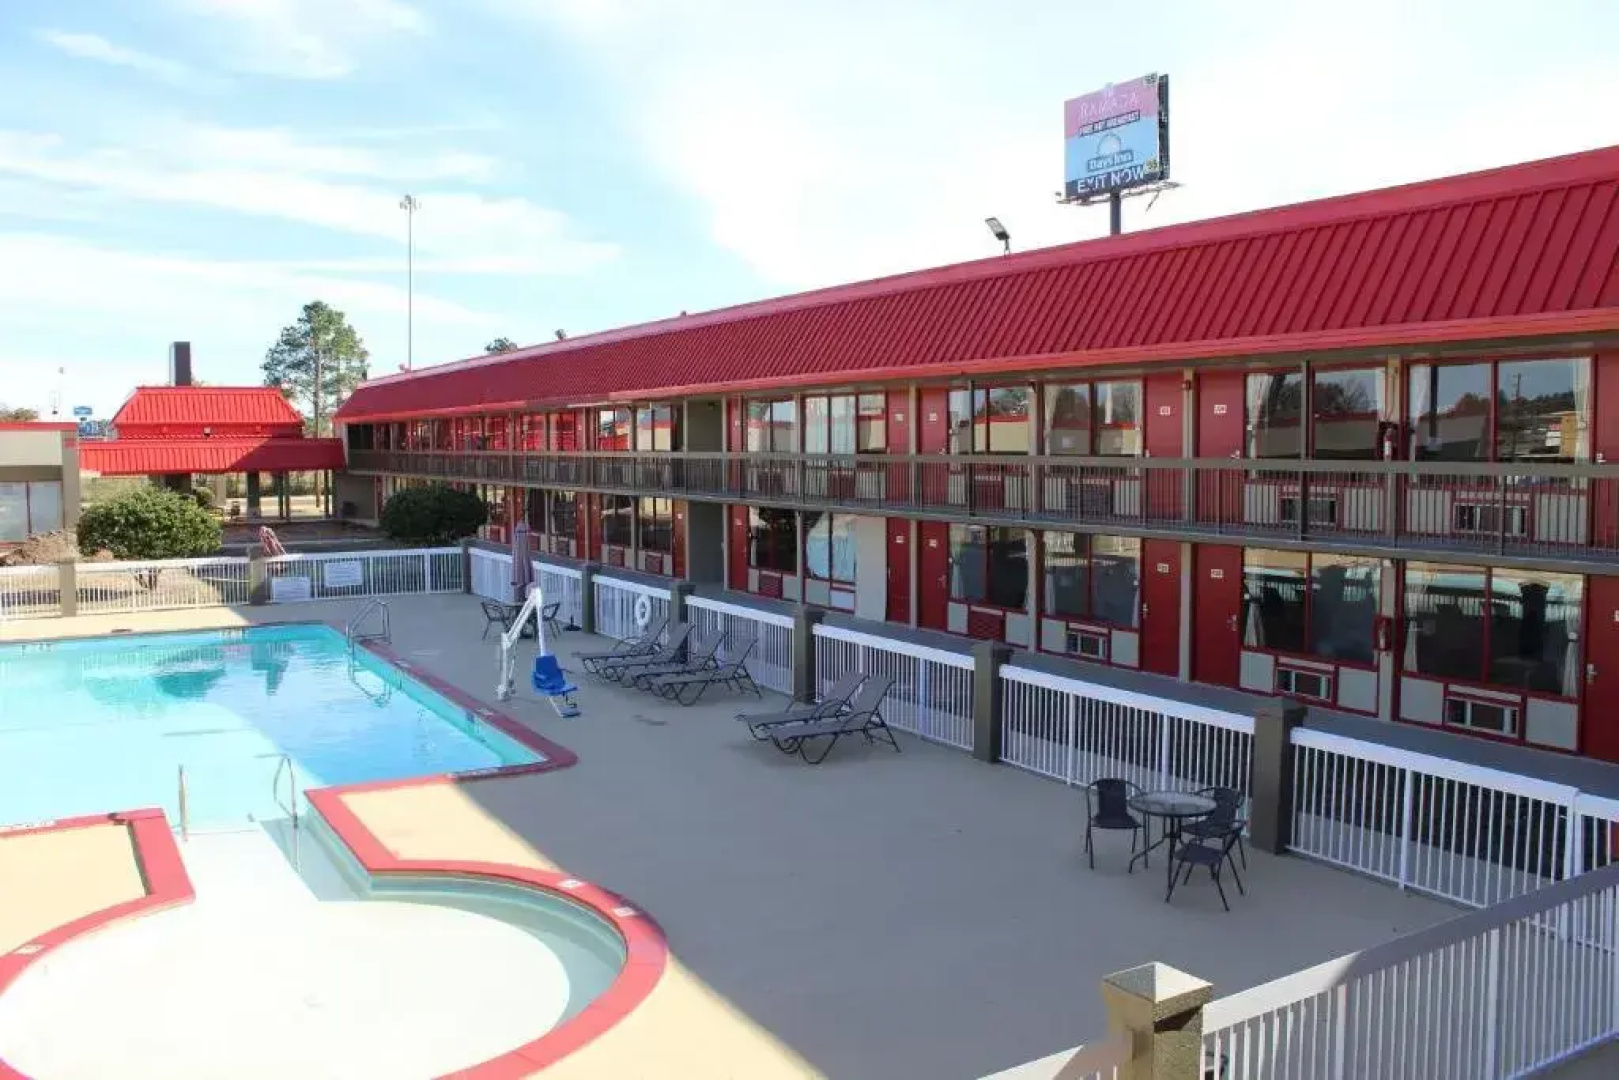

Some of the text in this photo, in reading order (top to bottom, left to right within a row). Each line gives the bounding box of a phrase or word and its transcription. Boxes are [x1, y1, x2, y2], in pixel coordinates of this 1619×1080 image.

[1089, 151, 1131, 169] Days Inn
[1078, 166, 1144, 193] EXIT NOW
